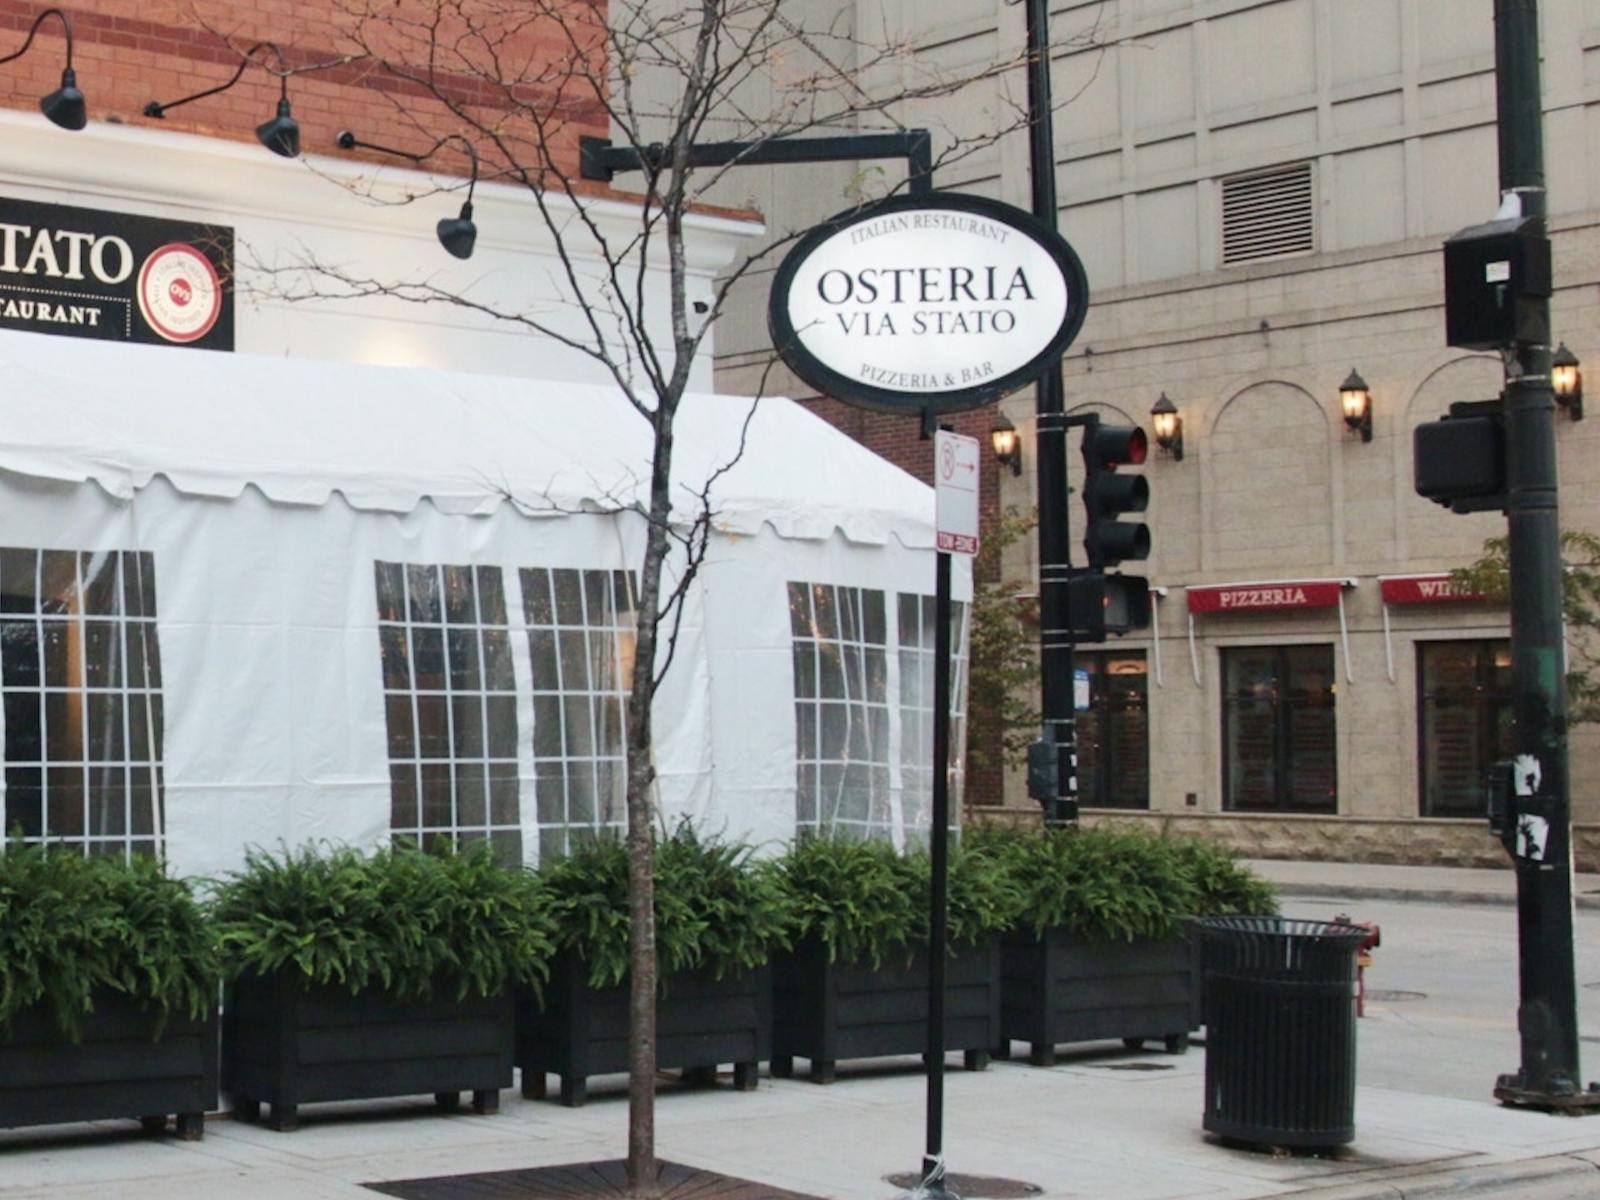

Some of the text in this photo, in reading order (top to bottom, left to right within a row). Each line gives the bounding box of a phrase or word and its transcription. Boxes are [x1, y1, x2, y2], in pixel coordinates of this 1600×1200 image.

[850, 213, 1009, 245] ITALIAN RESTAURANT
[816, 265, 1037, 305] OSTERIA
[835, 309, 1016, 336] VIA STATO
[859, 360, 995, 387] PIZZERIA & BAR
[1219, 587, 1307, 607] PIZZERIA
